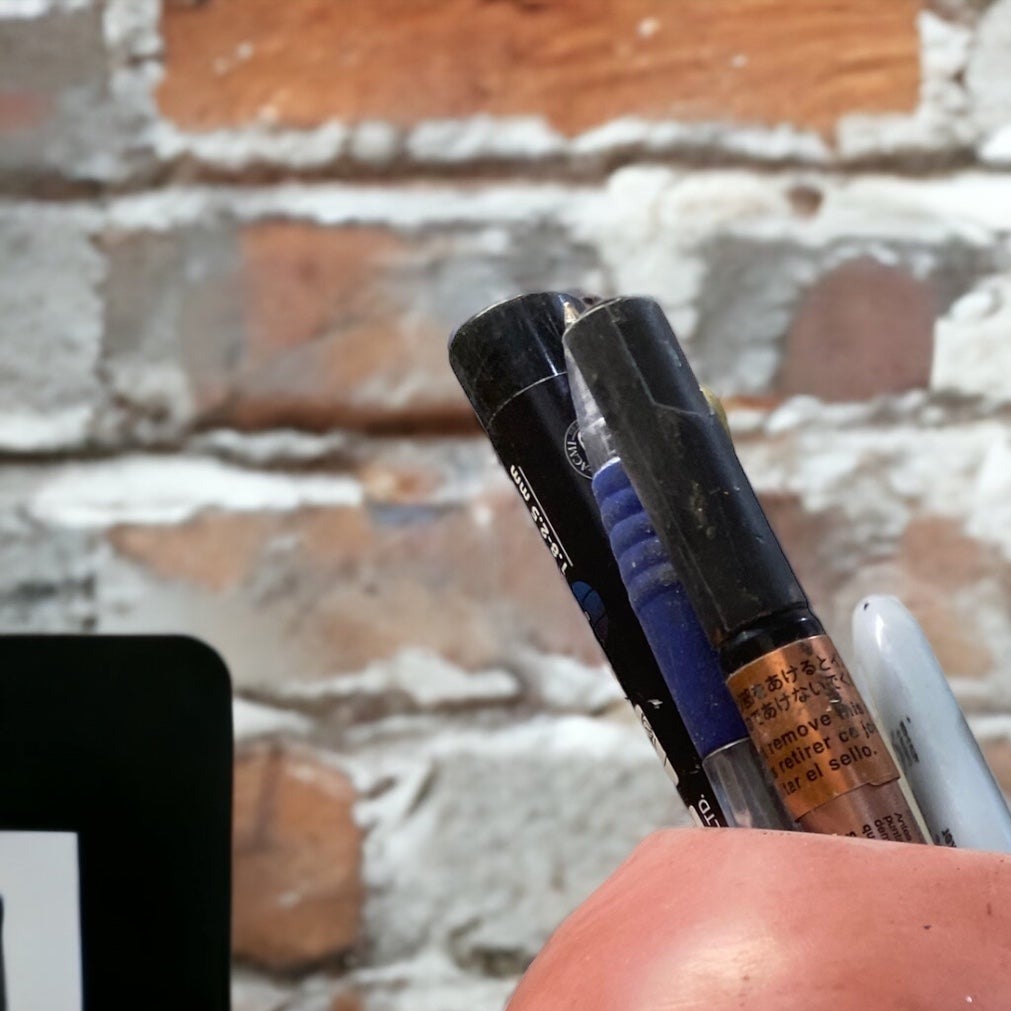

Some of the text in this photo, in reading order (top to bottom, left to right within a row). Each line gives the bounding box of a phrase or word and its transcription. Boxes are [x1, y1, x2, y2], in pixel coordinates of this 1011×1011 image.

[509, 464, 531, 502] mm
[768, 713, 832, 755] remove
[778, 737, 832, 774] retirer
[806, 766, 824, 782] el
[828, 745, 878, 771] sello.
[883, 815, 900, 842] punt
